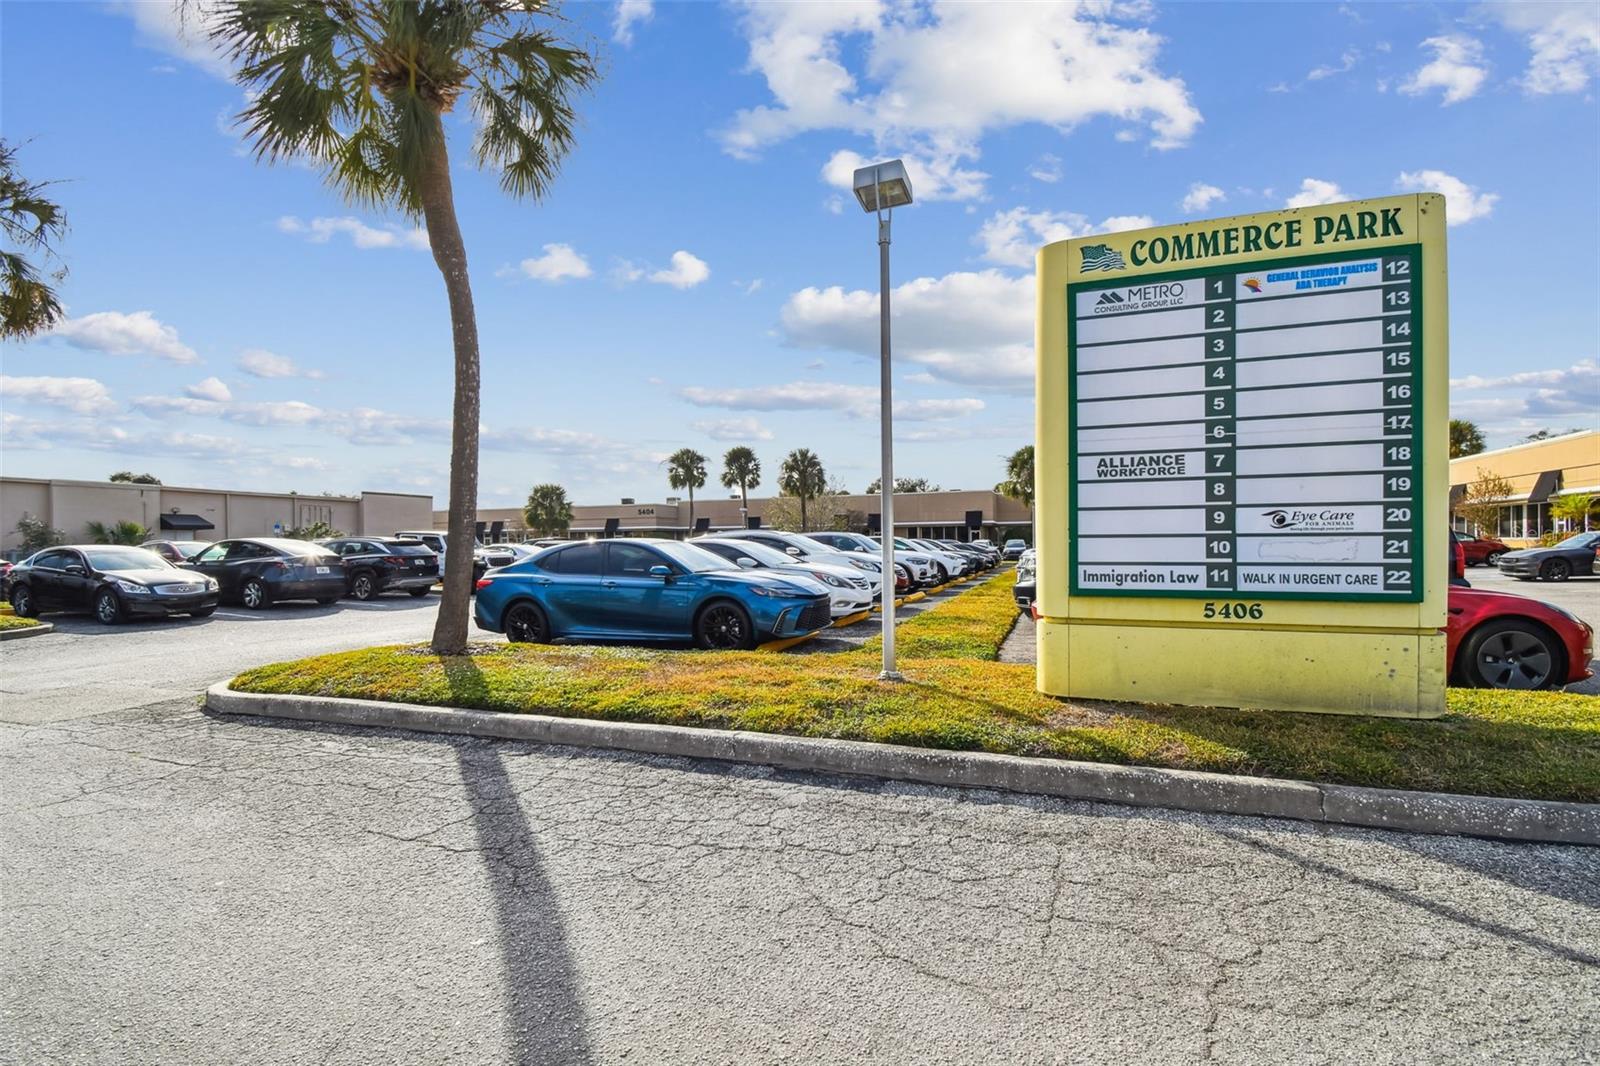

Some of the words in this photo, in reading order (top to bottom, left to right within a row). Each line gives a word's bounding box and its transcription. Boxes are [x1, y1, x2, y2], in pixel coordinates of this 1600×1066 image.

[1130, 220, 1302, 266] COMMERCE
[1313, 208, 1404, 245] PARK
[1266, 272, 1300, 283] GENERAL
[1301, 266, 1340, 279] BEHAVIOR
[1341, 262, 1378, 275] ANALYSIS
[1386, 260, 1410, 275] 12
[1213, 281, 1223, 294] 1
[1313, 276, 1348, 288] THERAPY
[1128, 283, 1184, 302] METRO
[1386, 291, 1410, 305] 13
[1094, 303, 1139, 314] CONSULTING
[1170, 297, 1184, 305] LLC
[1213, 309, 1225, 323] 2
[1386, 322, 1411, 337] 14
[1213, 339, 1224, 352] 3
[1386, 351, 1410, 367] 15
[1213, 366, 1225, 380] 4
[1387, 384, 1411, 399] 16
[1213, 397, 1225, 410] 5
[1387, 415, 1411, 429] 17
[1213, 425, 1225, 439] 6
[1387, 446, 1411, 460] 18
[1096, 454, 1185, 469] ALLIANCE
[1214, 455, 1225, 467] 7
[1096, 466, 1185, 478] WORKFORCE
[1213, 483, 1225, 495] 8
[1387, 477, 1411, 491] 19
[1213, 511, 1225, 524] 9
[1291, 511, 1317, 523] Eye
[1319, 510, 1354, 520] Care
[1386, 508, 1411, 521] 20
[1210, 541, 1230, 554] 10
[1386, 540, 1409, 553] 21
[1083, 569, 1164, 586] Immigration
[1170, 570, 1199, 583] Law
[1210, 569, 1229, 582] 11
[1243, 573, 1276, 584] WALK
[1279, 573, 1290, 584] IN
[1294, 574, 1341, 585] URGENT
[1345, 574, 1378, 585] CARE
[1386, 571, 1411, 584] 22
[1204, 603, 1263, 619] 5406
